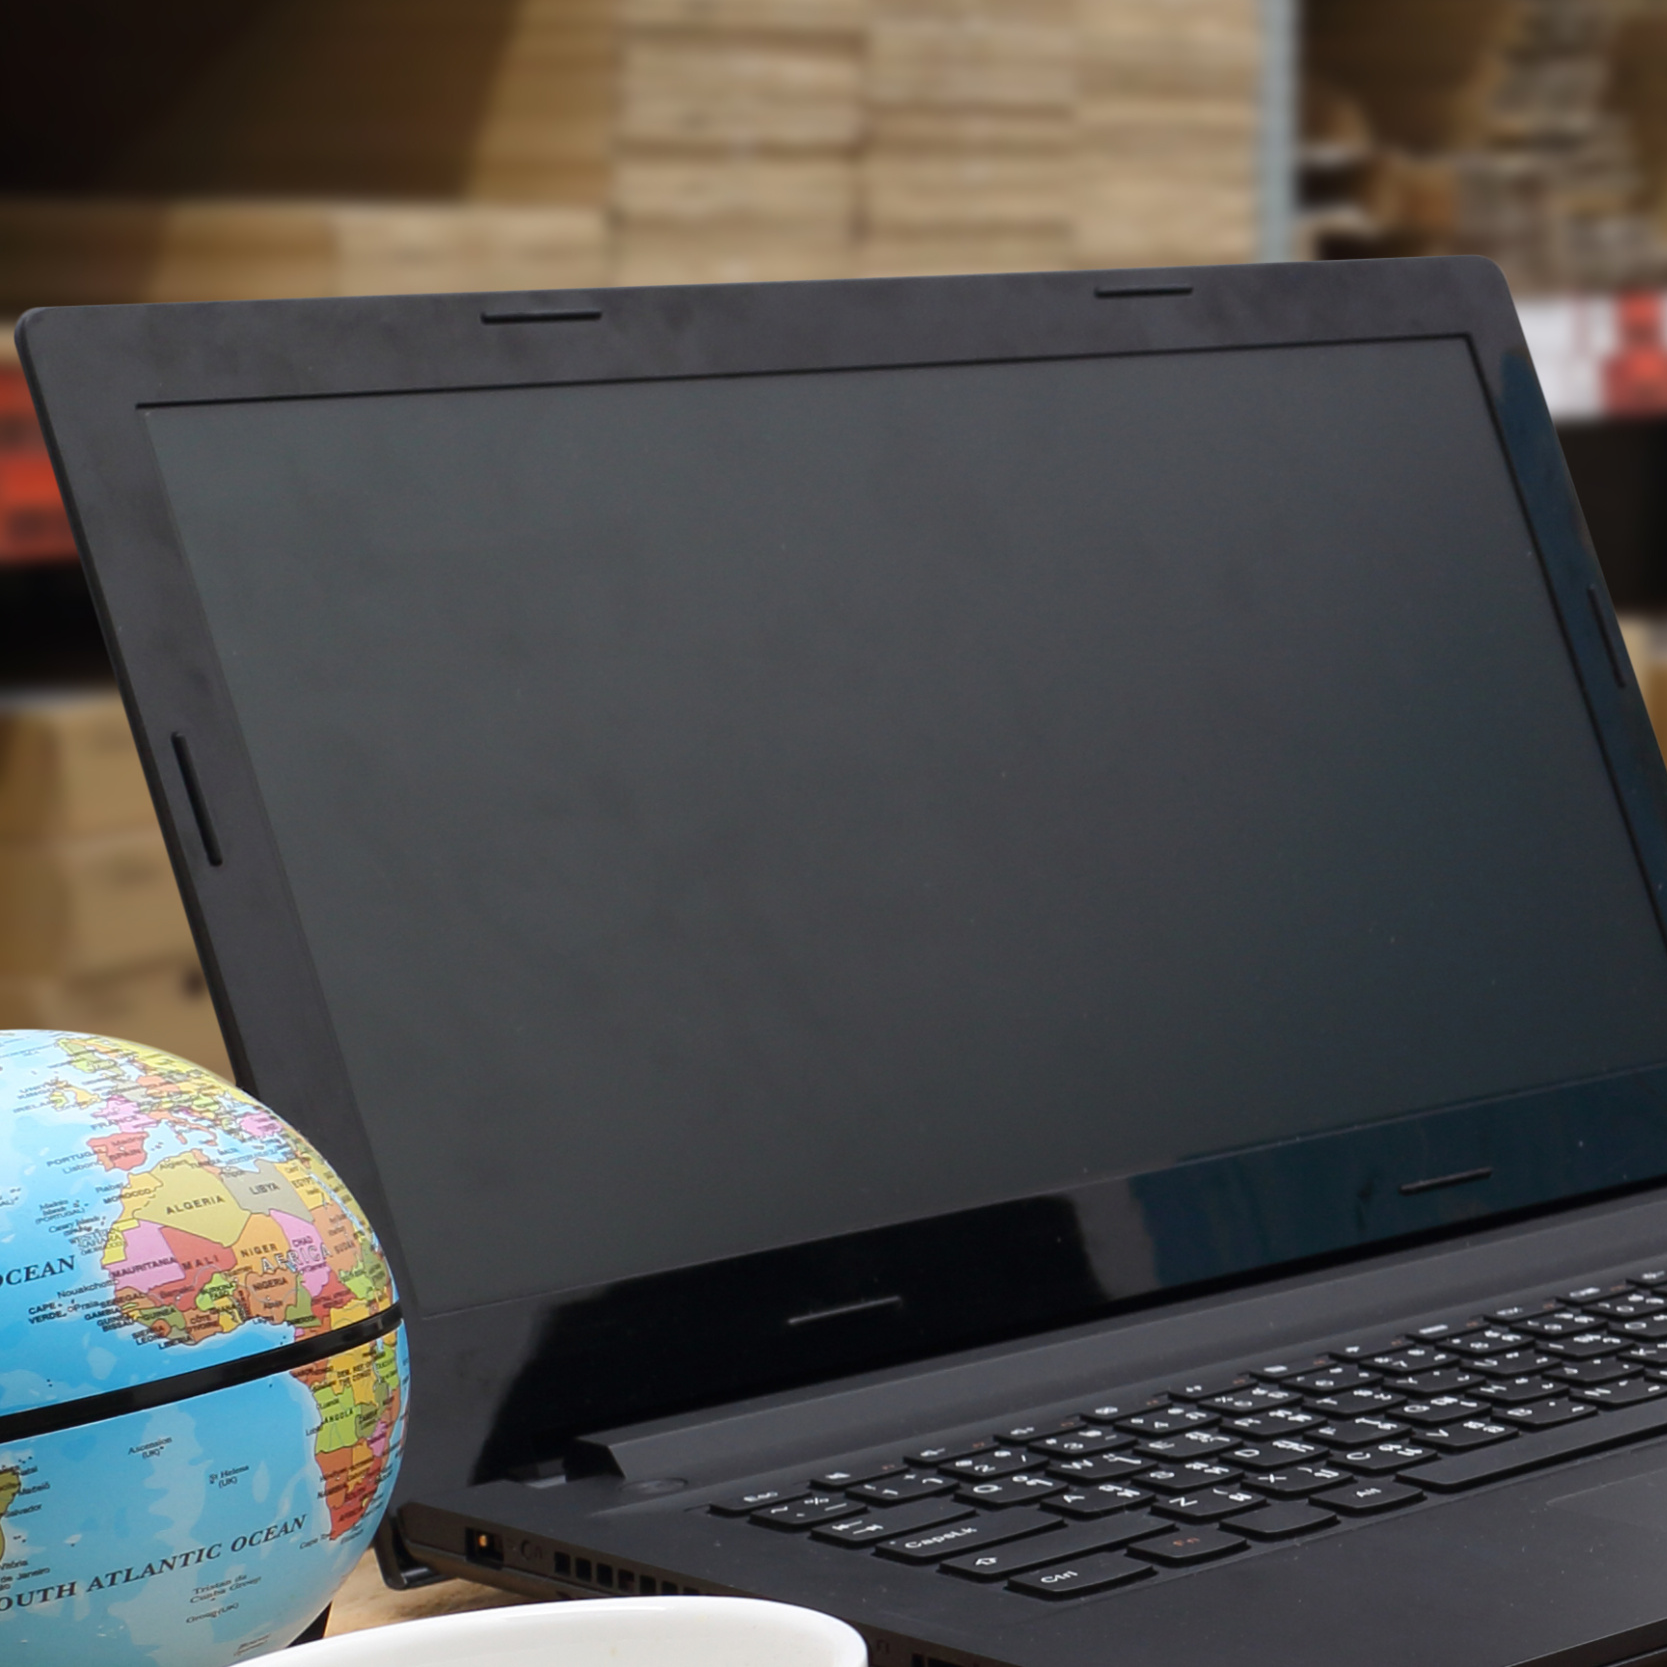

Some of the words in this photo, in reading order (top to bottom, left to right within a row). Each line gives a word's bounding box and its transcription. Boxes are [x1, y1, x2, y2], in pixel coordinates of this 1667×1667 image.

[249, 1182, 280, 1195] LIBYA
[166, 1194, 226, 1215] ALGERIA
[240, 1243, 278, 1257] NIGER
[261, 1243, 333, 1273] AFRICA
[0, 1255, 75, 1285] CEAN
[112, 1257, 177, 1277] MAURITANIA
[252, 1277, 288, 1291] NIGERIA
[28, 1303, 56, 1315] CAPE
[28, 1311, 65, 1324] VERDE
[323, 1407, 353, 1424] ANGOLA
[1149, 1441, 1175, 1450] E
[1234, 1449, 1260, 1457] D
[1347, 1452, 1371, 1460] C
[1061, 1460, 1093, 1469] W
[220, 1465, 250, 1478] Helena
[1258, 1474, 1287, 1483] X
[973, 1485, 1002, 1493] Q
[1063, 1495, 1085, 1503] A
[1169, 1497, 1198, 1507] Z
[905, 1527, 977, 1548] CapsLk
[0, 1581, 77, 1612] OUTH
[86, 1543, 222, 1593] ATLANTIC
[230, 1514, 307, 1552] OCEAN
[1041, 1570, 1078, 1583] Ctrl
